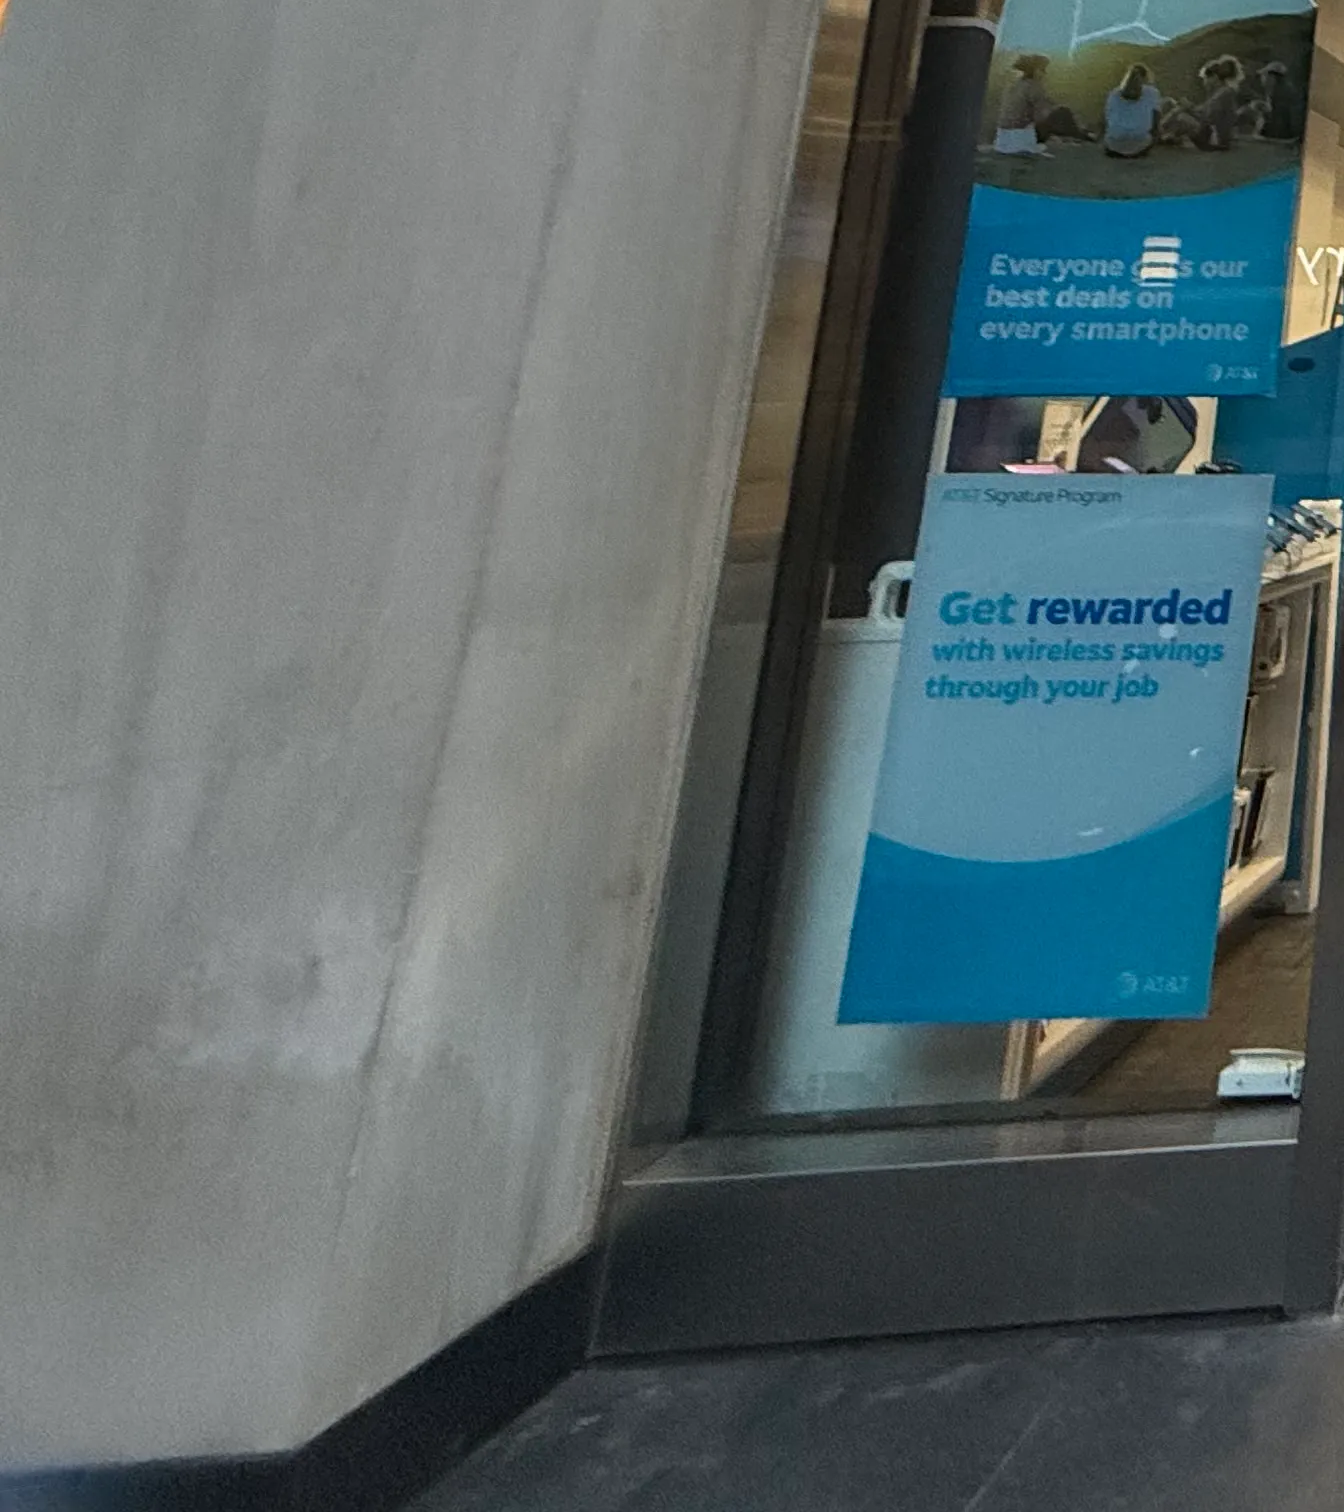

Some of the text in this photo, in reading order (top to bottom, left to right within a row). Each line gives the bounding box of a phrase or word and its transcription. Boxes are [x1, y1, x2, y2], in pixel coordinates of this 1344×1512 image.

[990, 254, 1124, 281] Everyone
[1200, 259, 1249, 278] our
[985, 284, 1174, 308] best deals on
[980, 317, 1249, 346] every smartphone
[984, 488, 1054, 507] Signature
[1057, 488, 1123, 506] Program
[939, 589, 1233, 626] Get rewarded
[932, 638, 1224, 667] with wireless savings
[925, 673, 1160, 705] through your job
